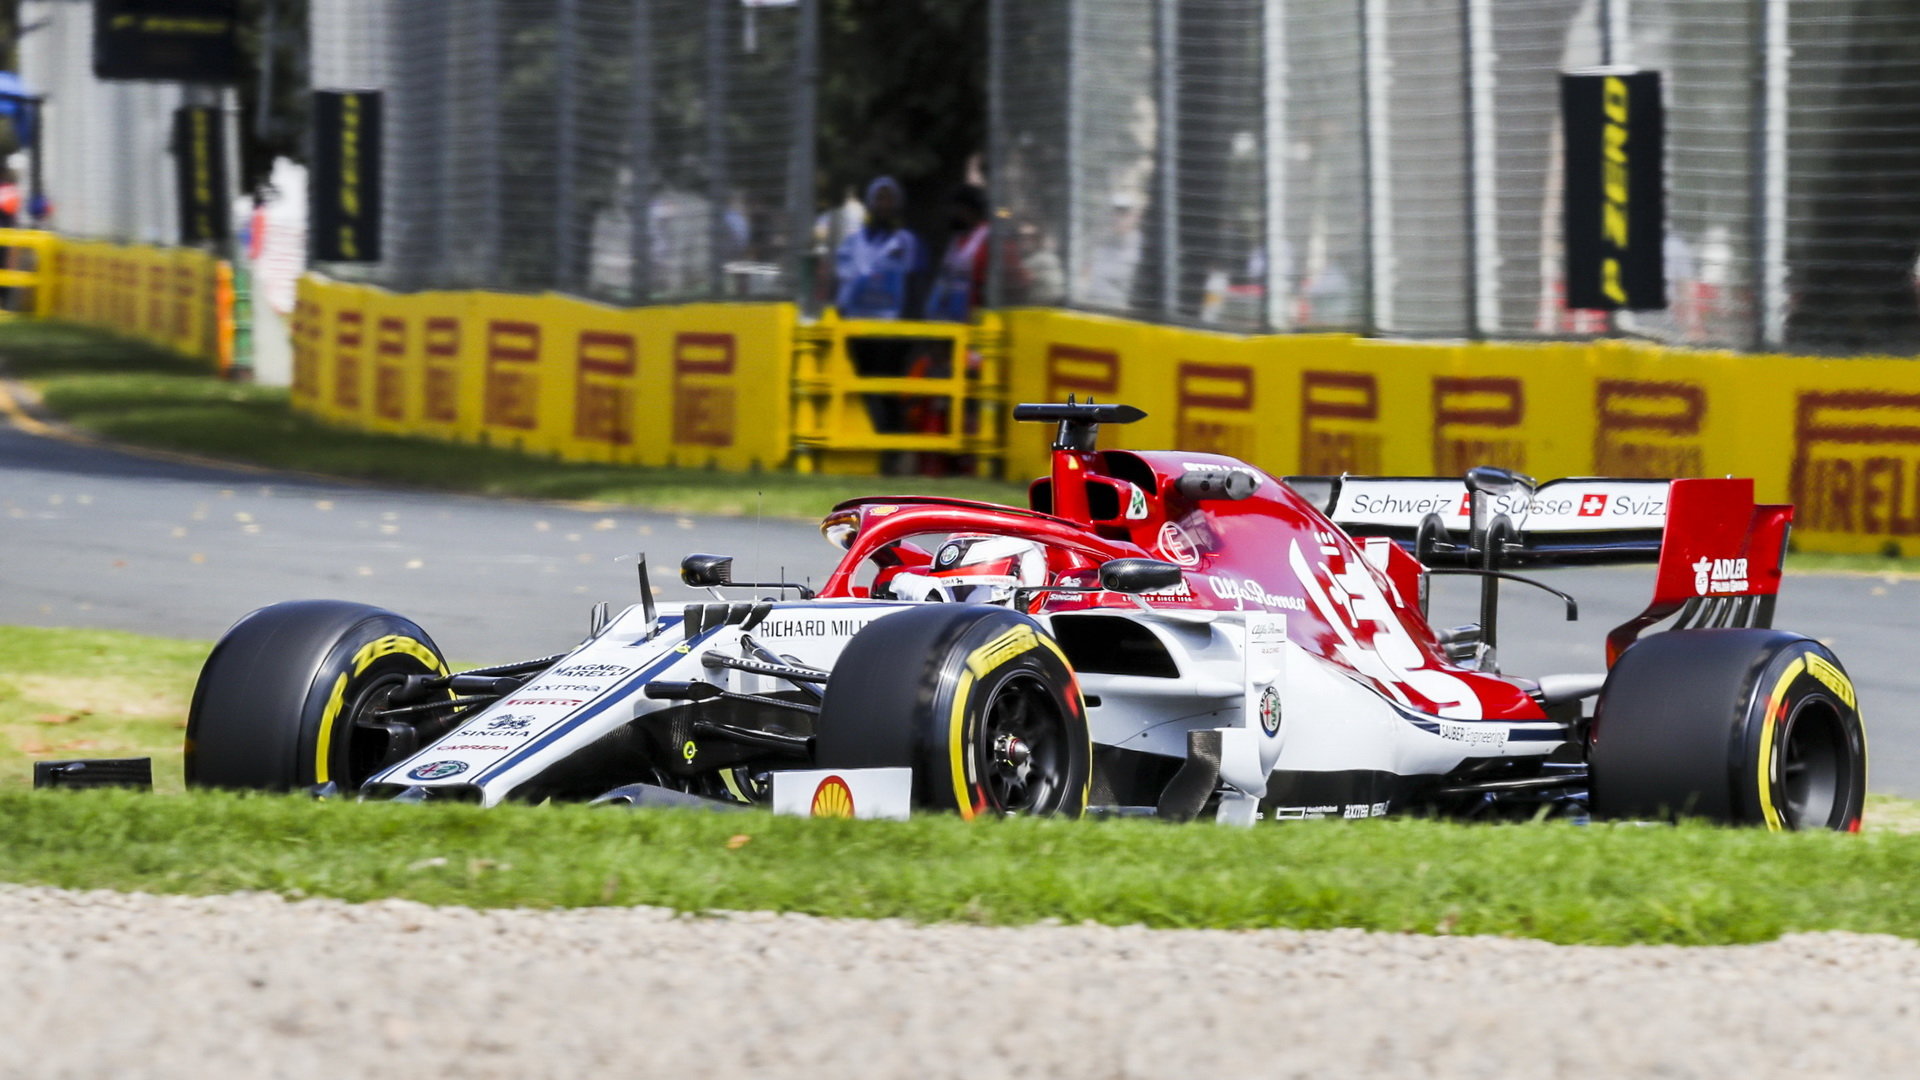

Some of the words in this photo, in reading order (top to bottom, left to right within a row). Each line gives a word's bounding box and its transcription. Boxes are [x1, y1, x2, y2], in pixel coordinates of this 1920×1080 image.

[1604, 76, 1628, 247] ZERO
[1352, 494, 1451, 514] Schweiz
[1493, 495, 1573, 516] Susse
[1612, 496, 1667, 516] Sviz
[1711, 558, 1748, 580] ADLER
[760, 620, 826, 638] RICHARD
[1442, 724, 1465, 741] SAUBER
[1465, 728, 1506, 748] Engineering
